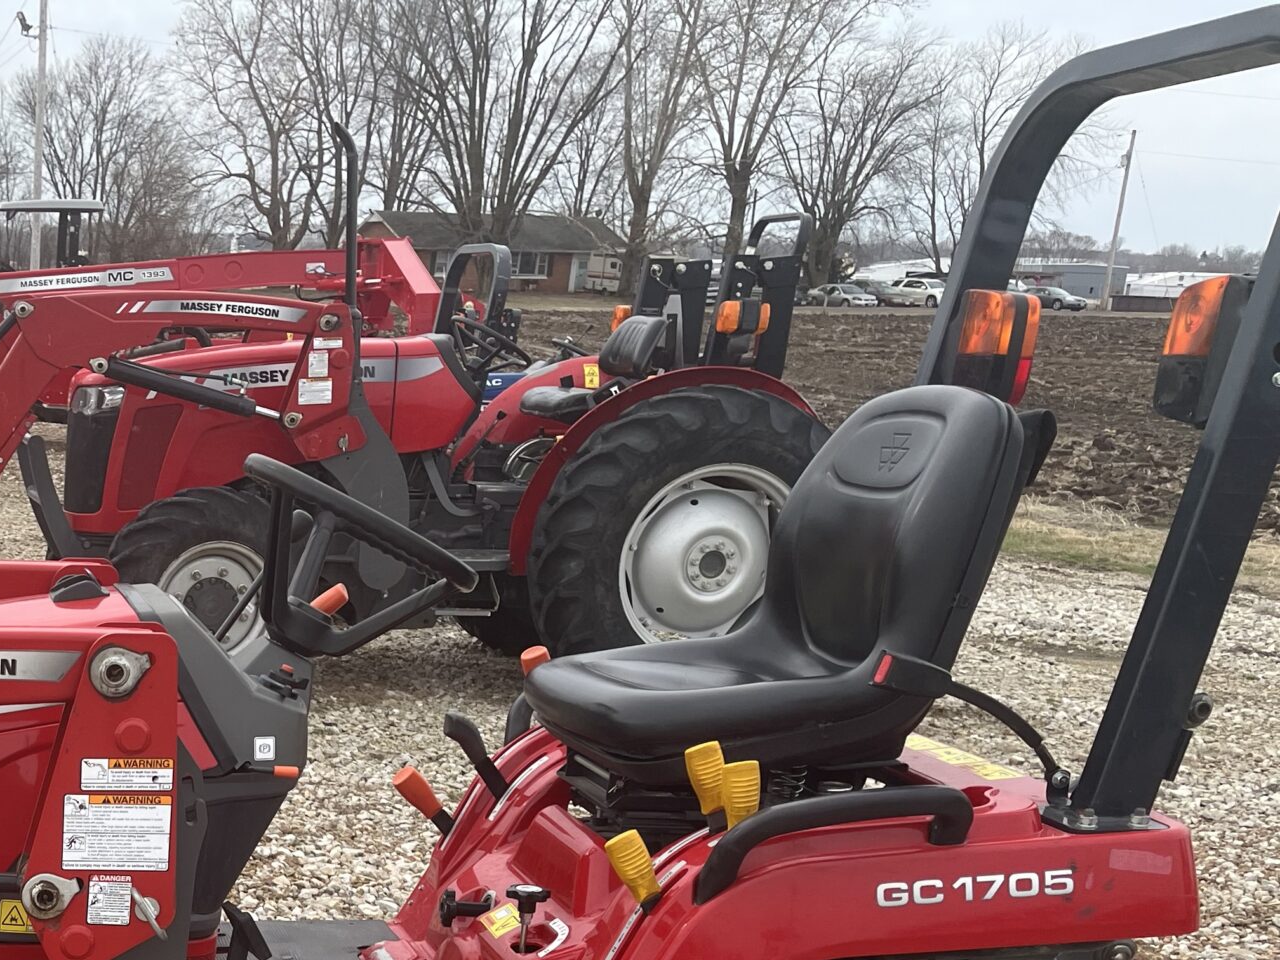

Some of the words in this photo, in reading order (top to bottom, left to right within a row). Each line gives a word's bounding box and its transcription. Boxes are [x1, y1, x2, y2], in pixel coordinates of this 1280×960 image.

[20, 278, 53, 288] MASSEY
[56, 275, 100, 285] FERGUSON
[108, 271, 134, 282] MC
[141, 270, 166, 278] 1393
[180, 301, 222, 313] MASSEY
[225, 304, 280, 318] FERGUSON
[123, 760, 170, 768] WARNING
[113, 796, 162, 804] WARNING
[877, 879, 944, 907] GC
[952, 869, 1074, 902] 1705
